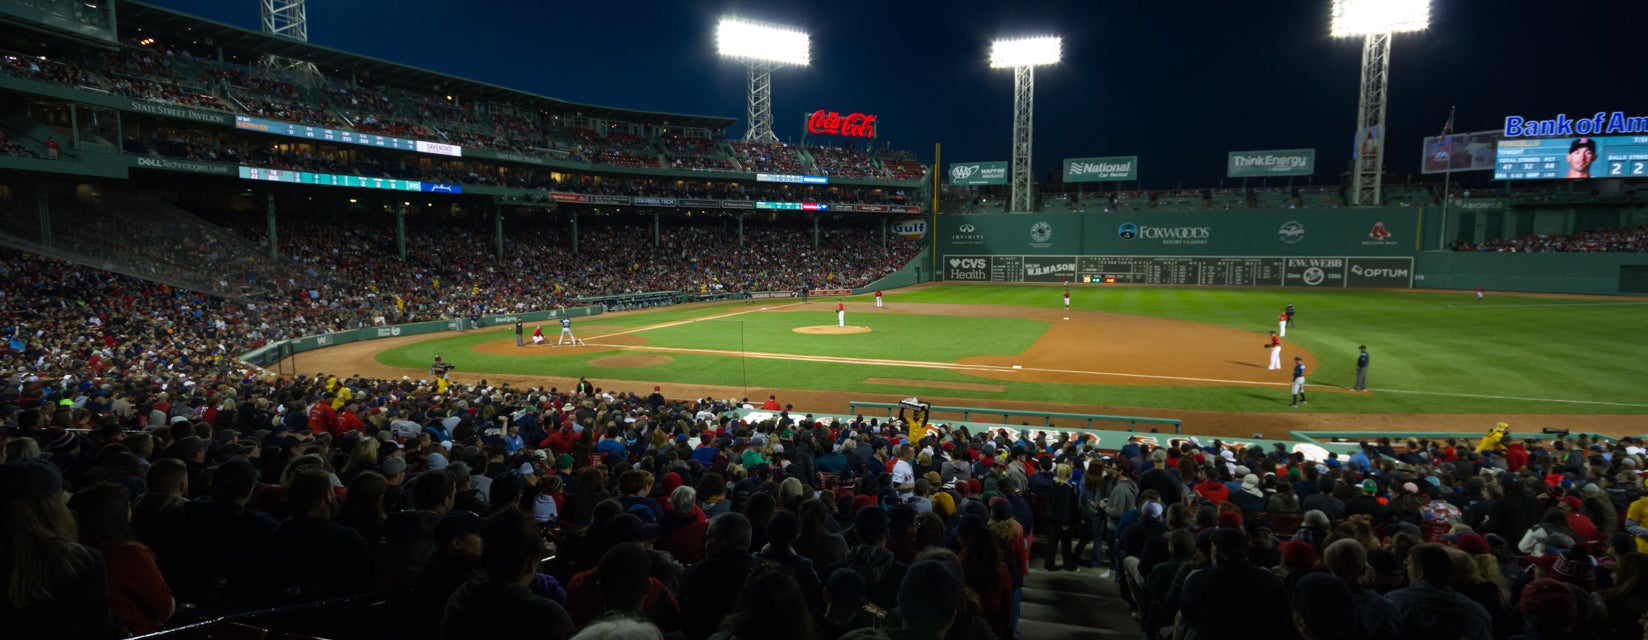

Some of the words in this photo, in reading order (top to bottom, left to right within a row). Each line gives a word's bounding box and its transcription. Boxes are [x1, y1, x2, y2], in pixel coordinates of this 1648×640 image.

[1504, 113, 1574, 137] Bank
[1575, 111, 1606, 135] of
[1083, 161, 1131, 173] National
[1611, 163, 1622, 174] 2
[1633, 162, 1644, 174] 2
[893, 222, 924, 232] Gulf
[1139, 226, 1210, 239] FOXWOODS
[961, 258, 986, 269] CVS
[1309, 259, 1343, 268] WEBB
[950, 269, 986, 279] Health
[1364, 268, 1408, 278] OPTUM
